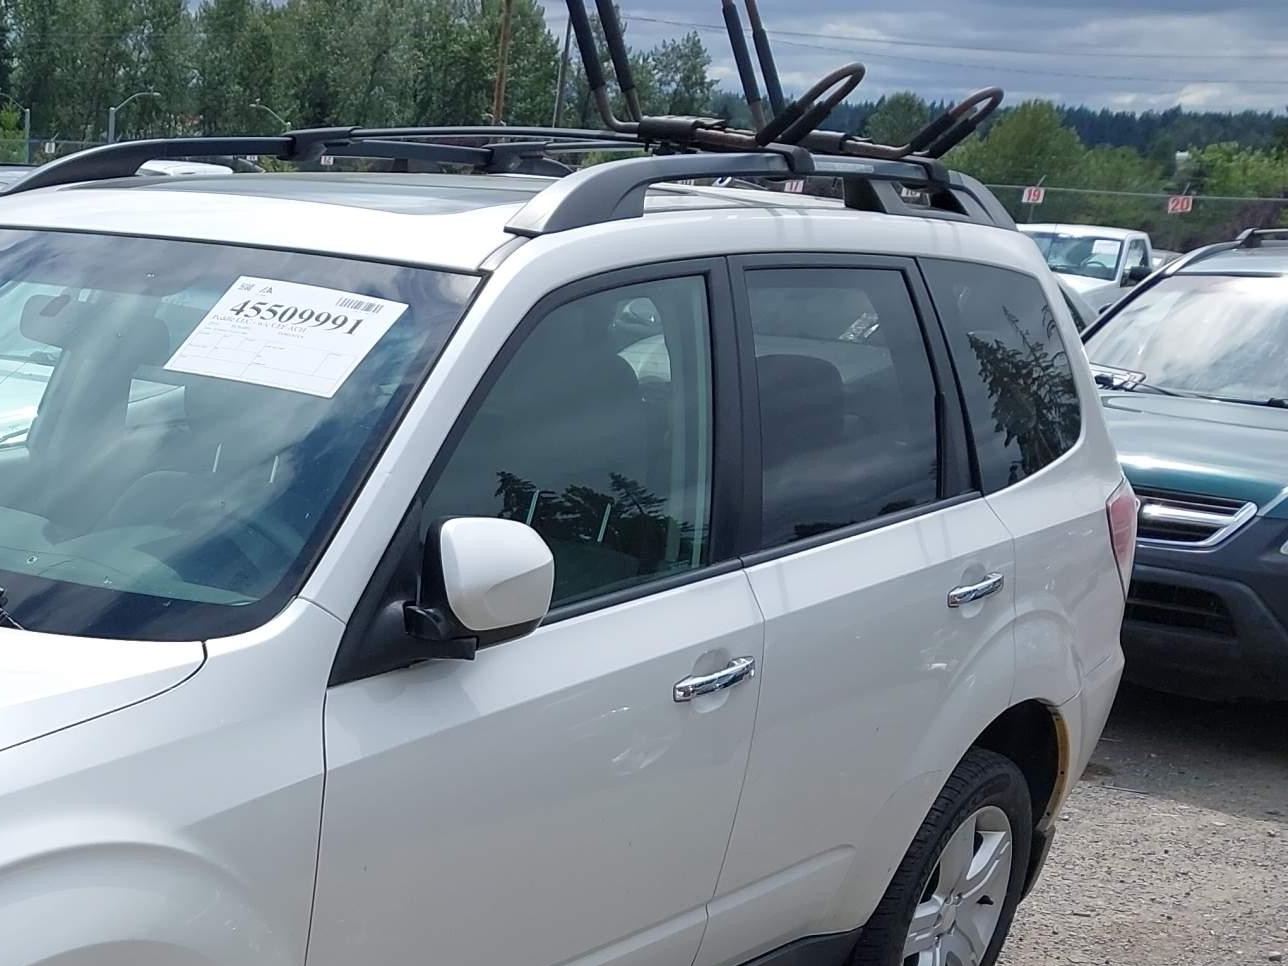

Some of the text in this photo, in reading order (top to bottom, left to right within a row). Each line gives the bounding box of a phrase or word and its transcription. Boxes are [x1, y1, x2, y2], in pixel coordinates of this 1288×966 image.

[1027, 187, 1041, 201] 19
[1171, 196, 1190, 211] 20
[229, 299, 365, 335] 45509991
